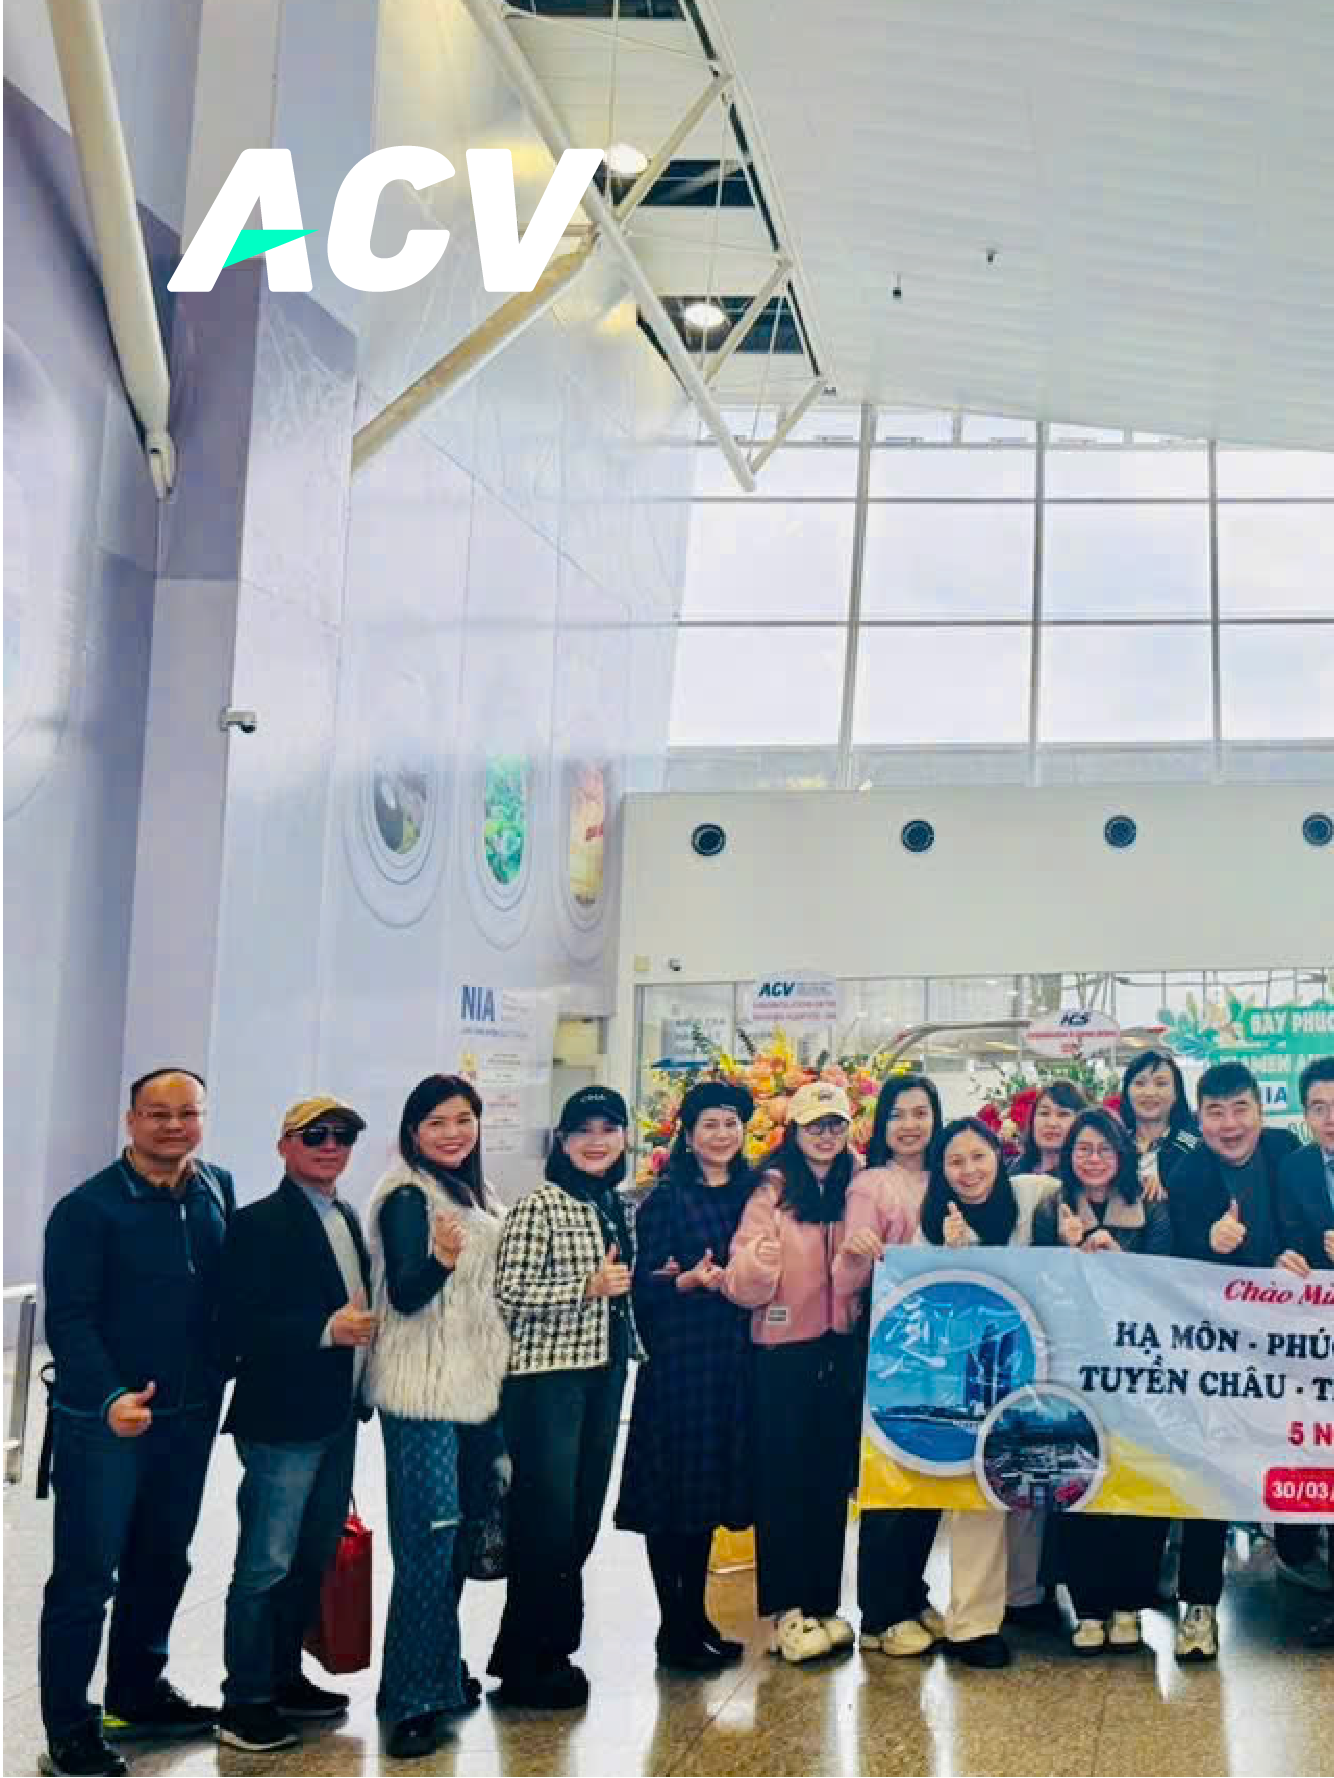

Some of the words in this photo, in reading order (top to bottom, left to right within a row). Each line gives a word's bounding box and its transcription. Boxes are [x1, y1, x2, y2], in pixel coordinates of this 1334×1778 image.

[758, 981, 796, 998] ACV
[461, 985, 496, 1022] NIA
[1251, 1010, 1287, 1035] BAY
[1223, 1279, 1294, 1304] Chào
[1114, 1320, 1161, 1355] HẠ
[1171, 1320, 1239, 1352] MÔN
[1199, 1365, 1287, 1399] CHÂU
[1287, 1420, 1305, 1447] 5
